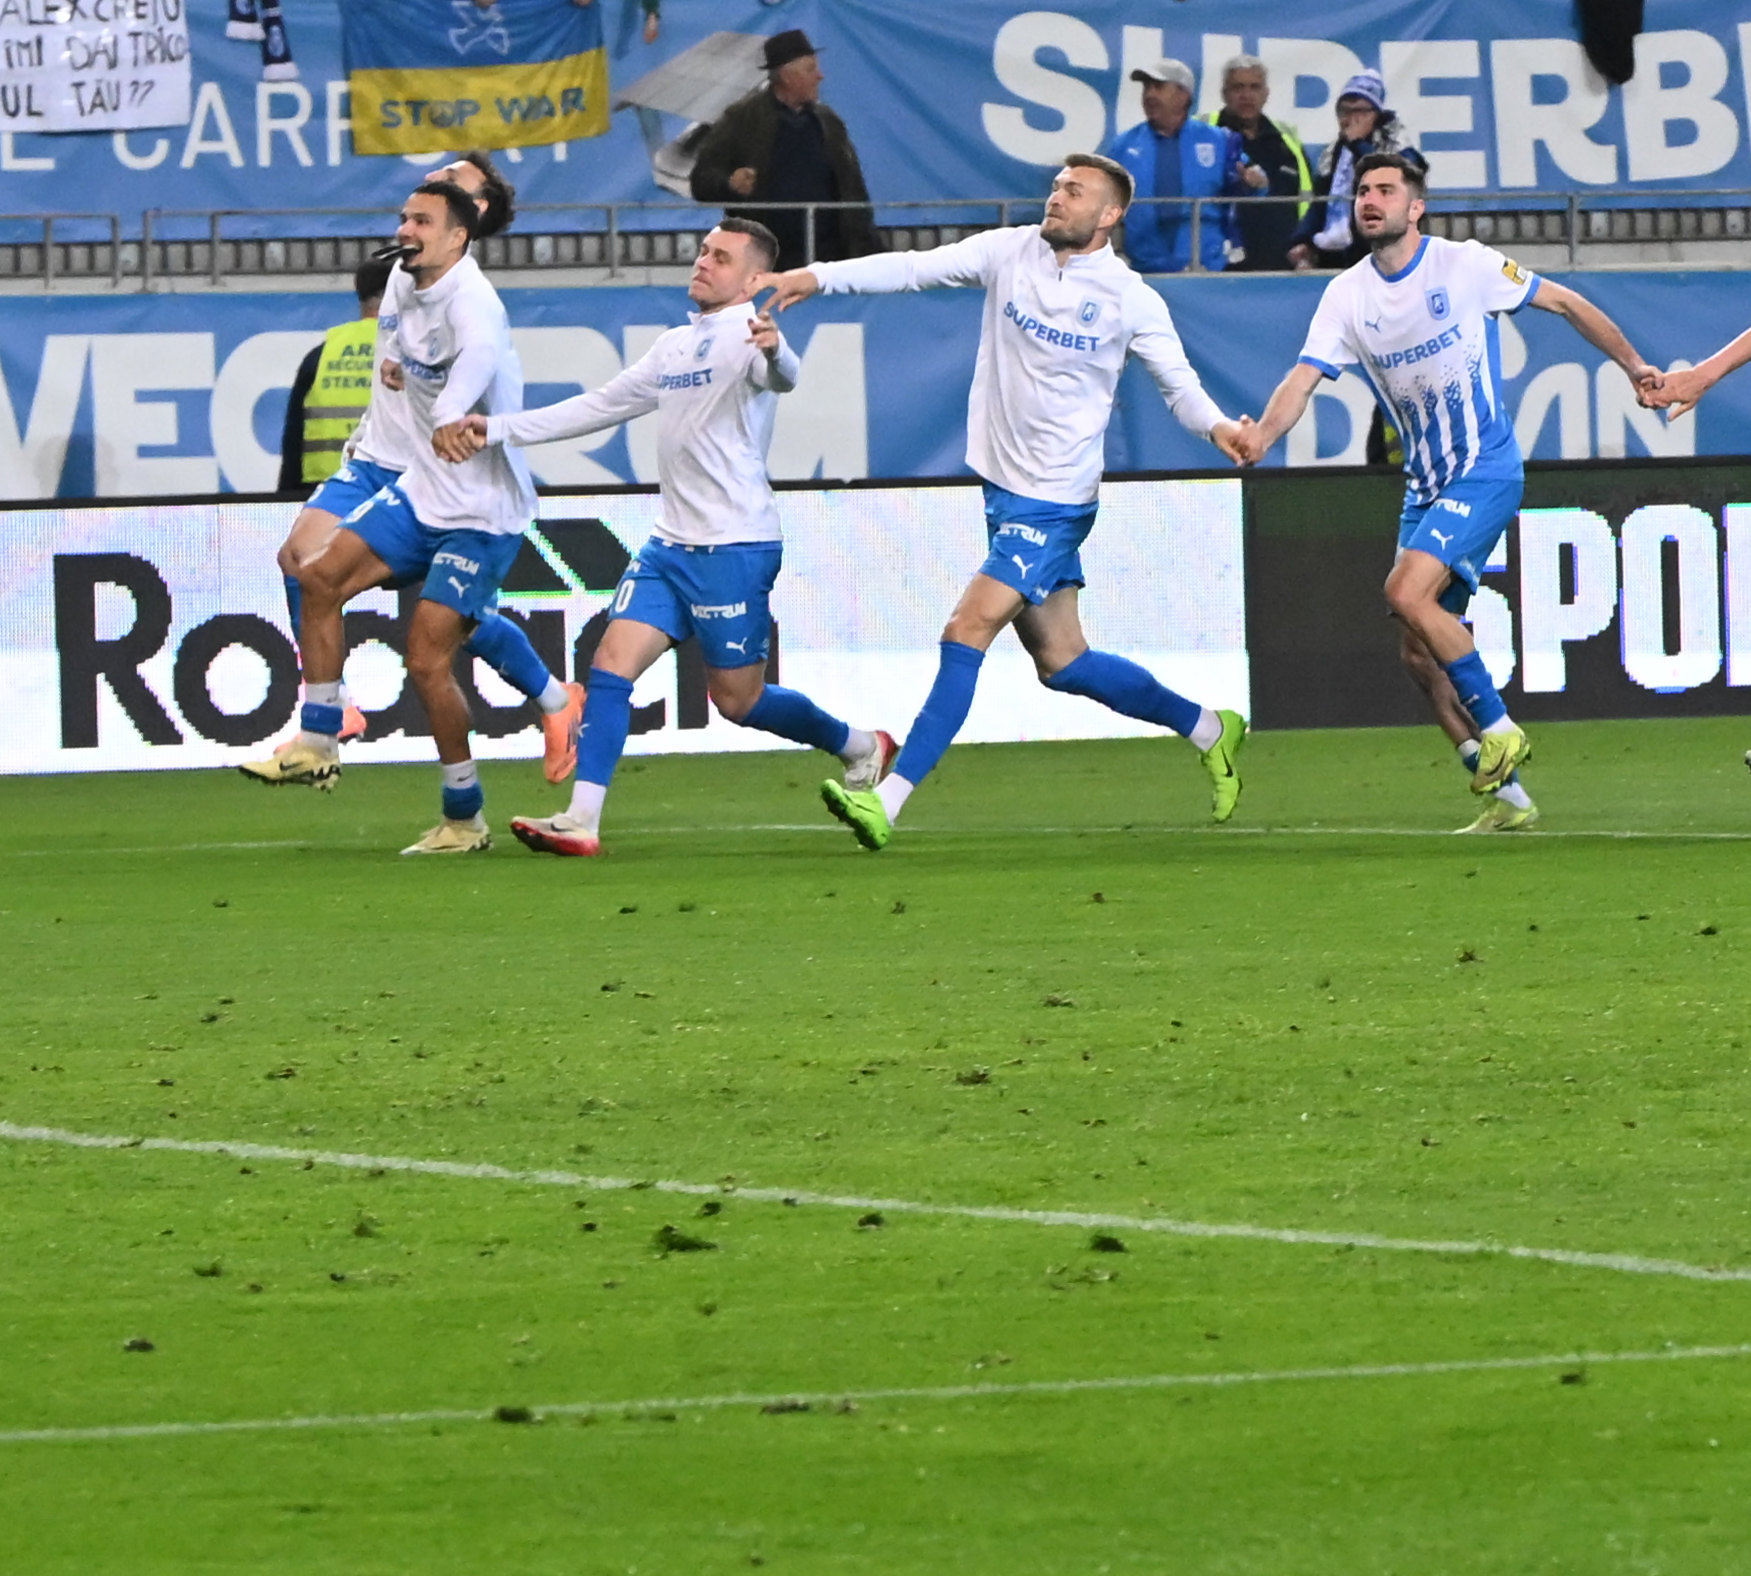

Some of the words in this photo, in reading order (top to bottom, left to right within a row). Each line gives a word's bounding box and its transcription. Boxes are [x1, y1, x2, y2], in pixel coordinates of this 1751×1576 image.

[0, 83, 44, 118] UL
[380, 97, 481, 129] STOP
[495, 85, 587, 124] WAR
[1003, 302, 1100, 352] SUPERBET
[343, 344, 371, 357] AR
